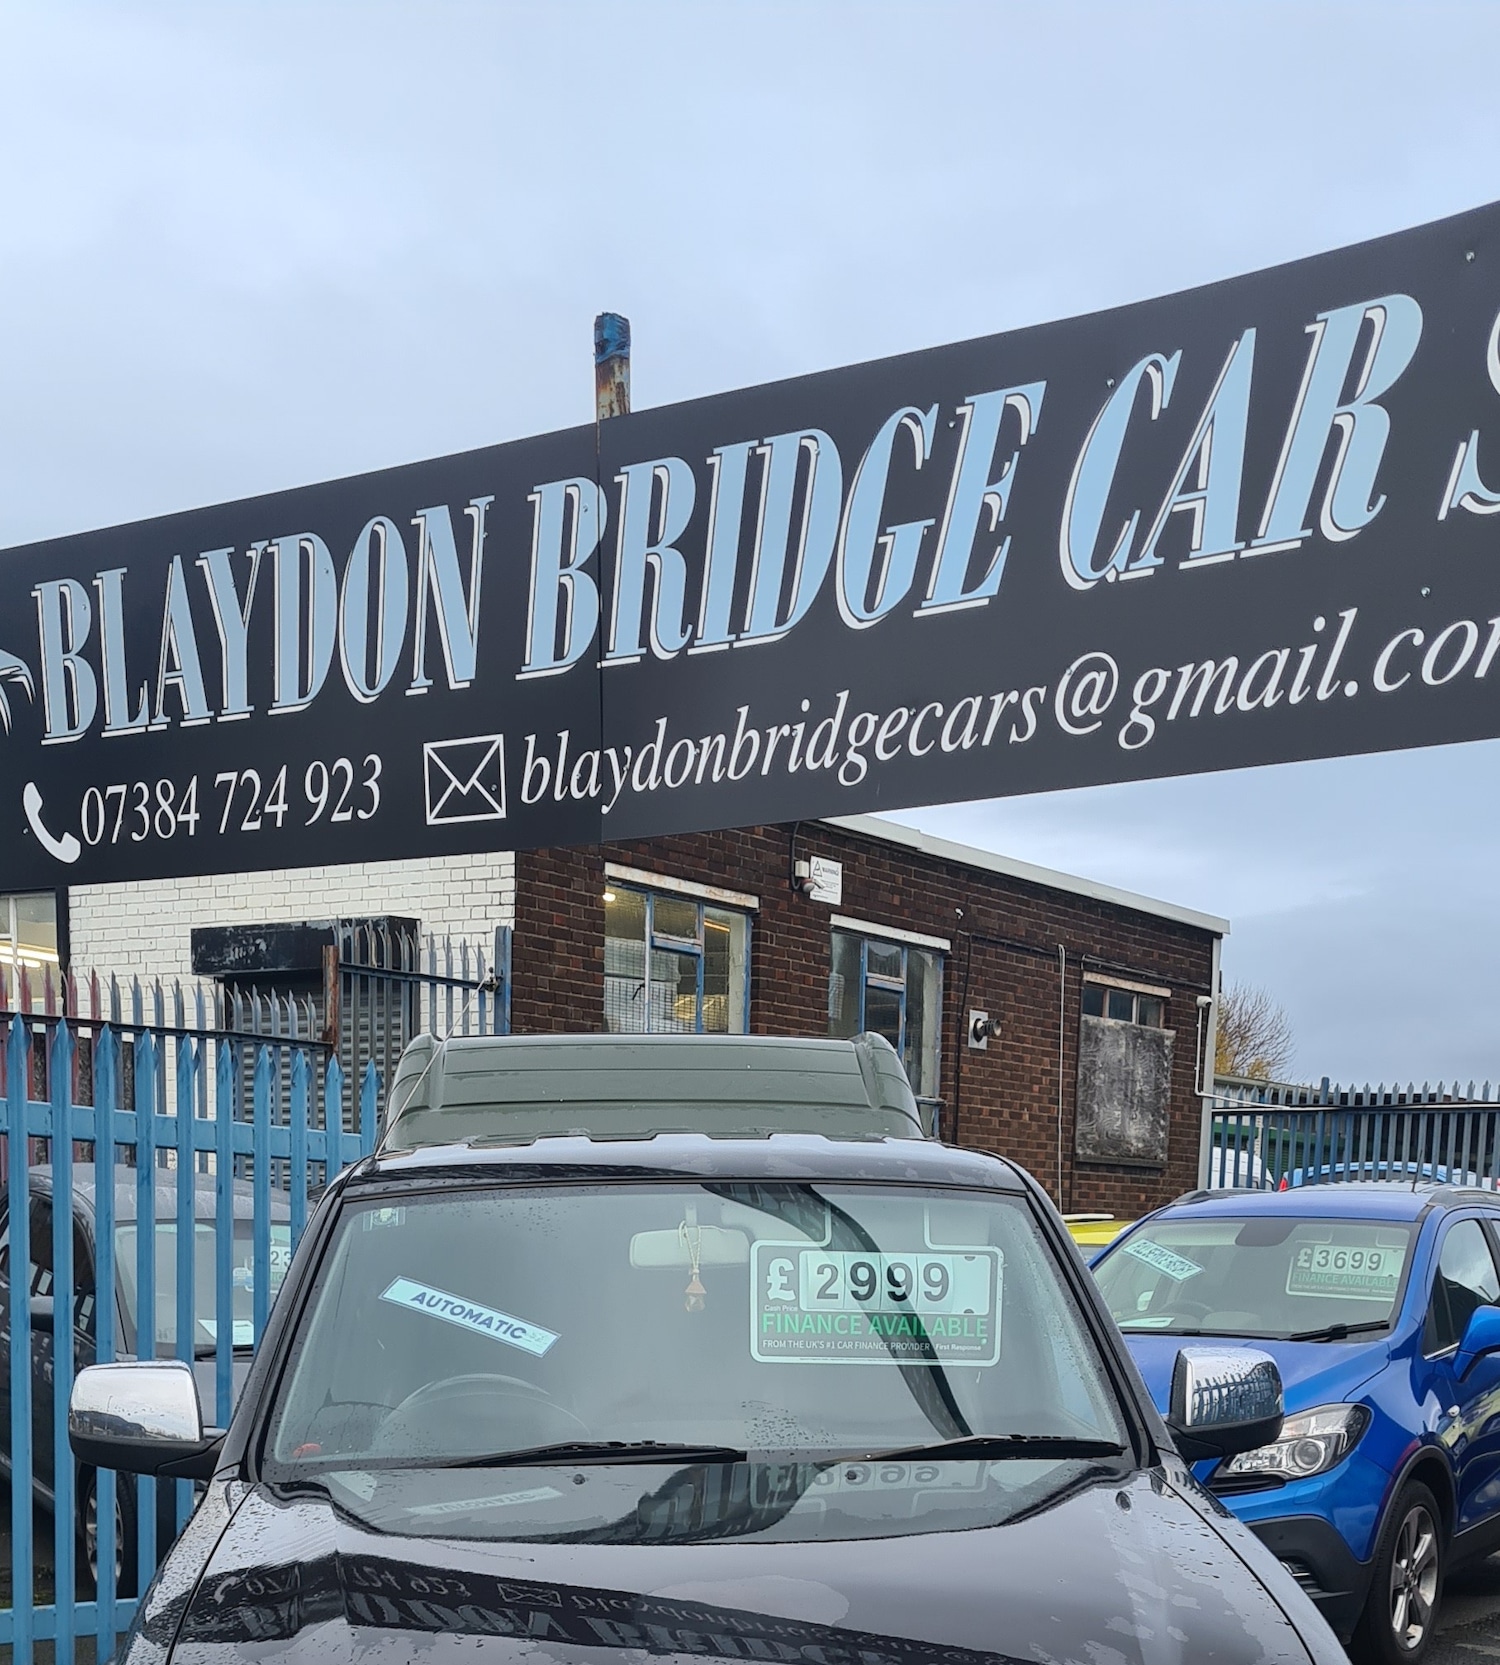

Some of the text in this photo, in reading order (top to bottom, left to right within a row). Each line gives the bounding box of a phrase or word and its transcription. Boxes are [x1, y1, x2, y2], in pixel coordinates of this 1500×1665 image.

[31, 495, 496, 746] BLAYDON
[515, 380, 1047, 680] BRIDGE
[1059, 293, 1424, 591] CAR
[520, 606, 1500, 815] blaydonbridgecars@gmail.co
[80, 753, 383, 846] 07384 724 923
[410, 1291, 527, 1339] AUTOMATIC
[762, 1313, 989, 1338] FINANCE AVAILABLE
[764, 1304, 782, 1312] Cash
[762, 1339, 930, 1351] FROM THE UK'S #1 CAR FINANCE PROVIDER
[935, 1343, 982, 1353] First Response
